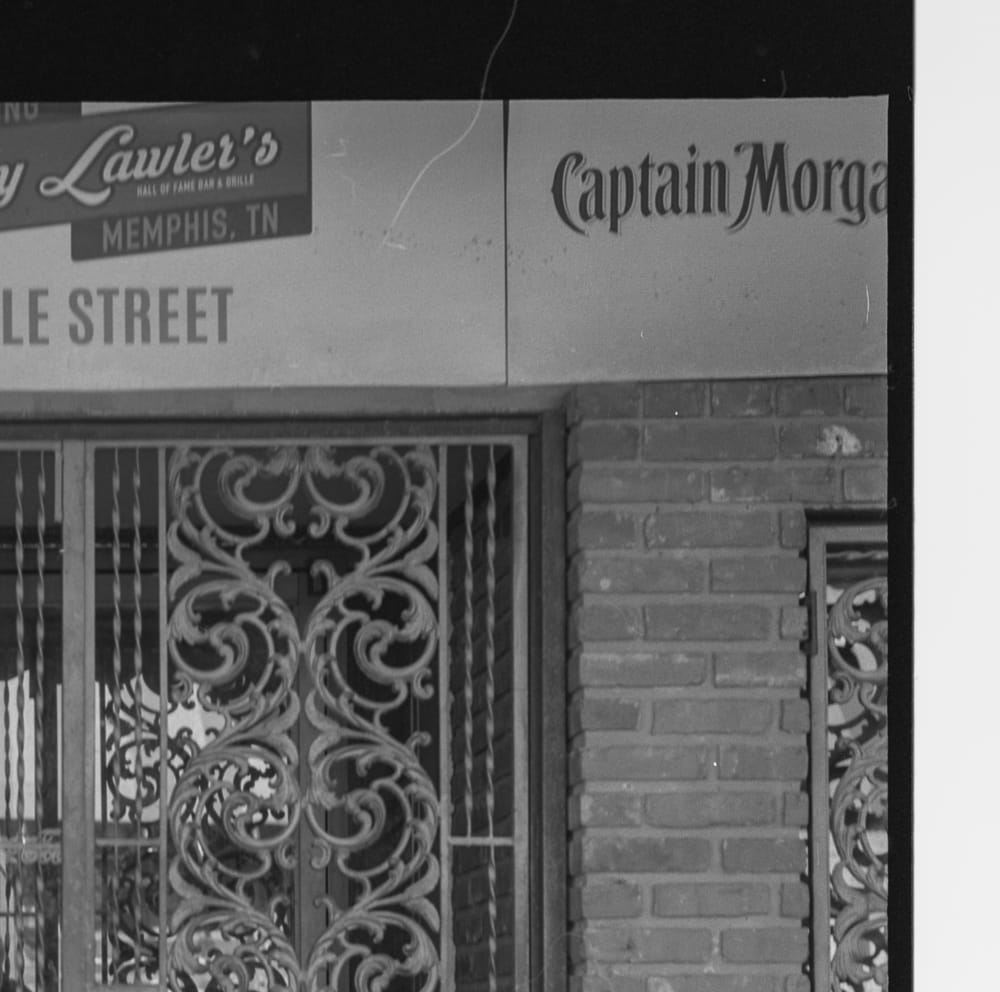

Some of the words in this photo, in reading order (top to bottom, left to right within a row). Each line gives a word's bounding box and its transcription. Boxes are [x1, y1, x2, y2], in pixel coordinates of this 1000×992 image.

[39, 124, 279, 207] Lawler's
[136, 183, 157, 198] HALL
[160, 181, 171, 195] OF
[173, 180, 195, 195] FAME
[198, 177, 215, 191] BAR
[217, 177, 223, 189] &
[550, 143, 731, 236] Captain
[102, 213, 236, 253] MEMPHIS,
[246, 202, 279, 236] TN
[68, 286, 234, 345] STREET
